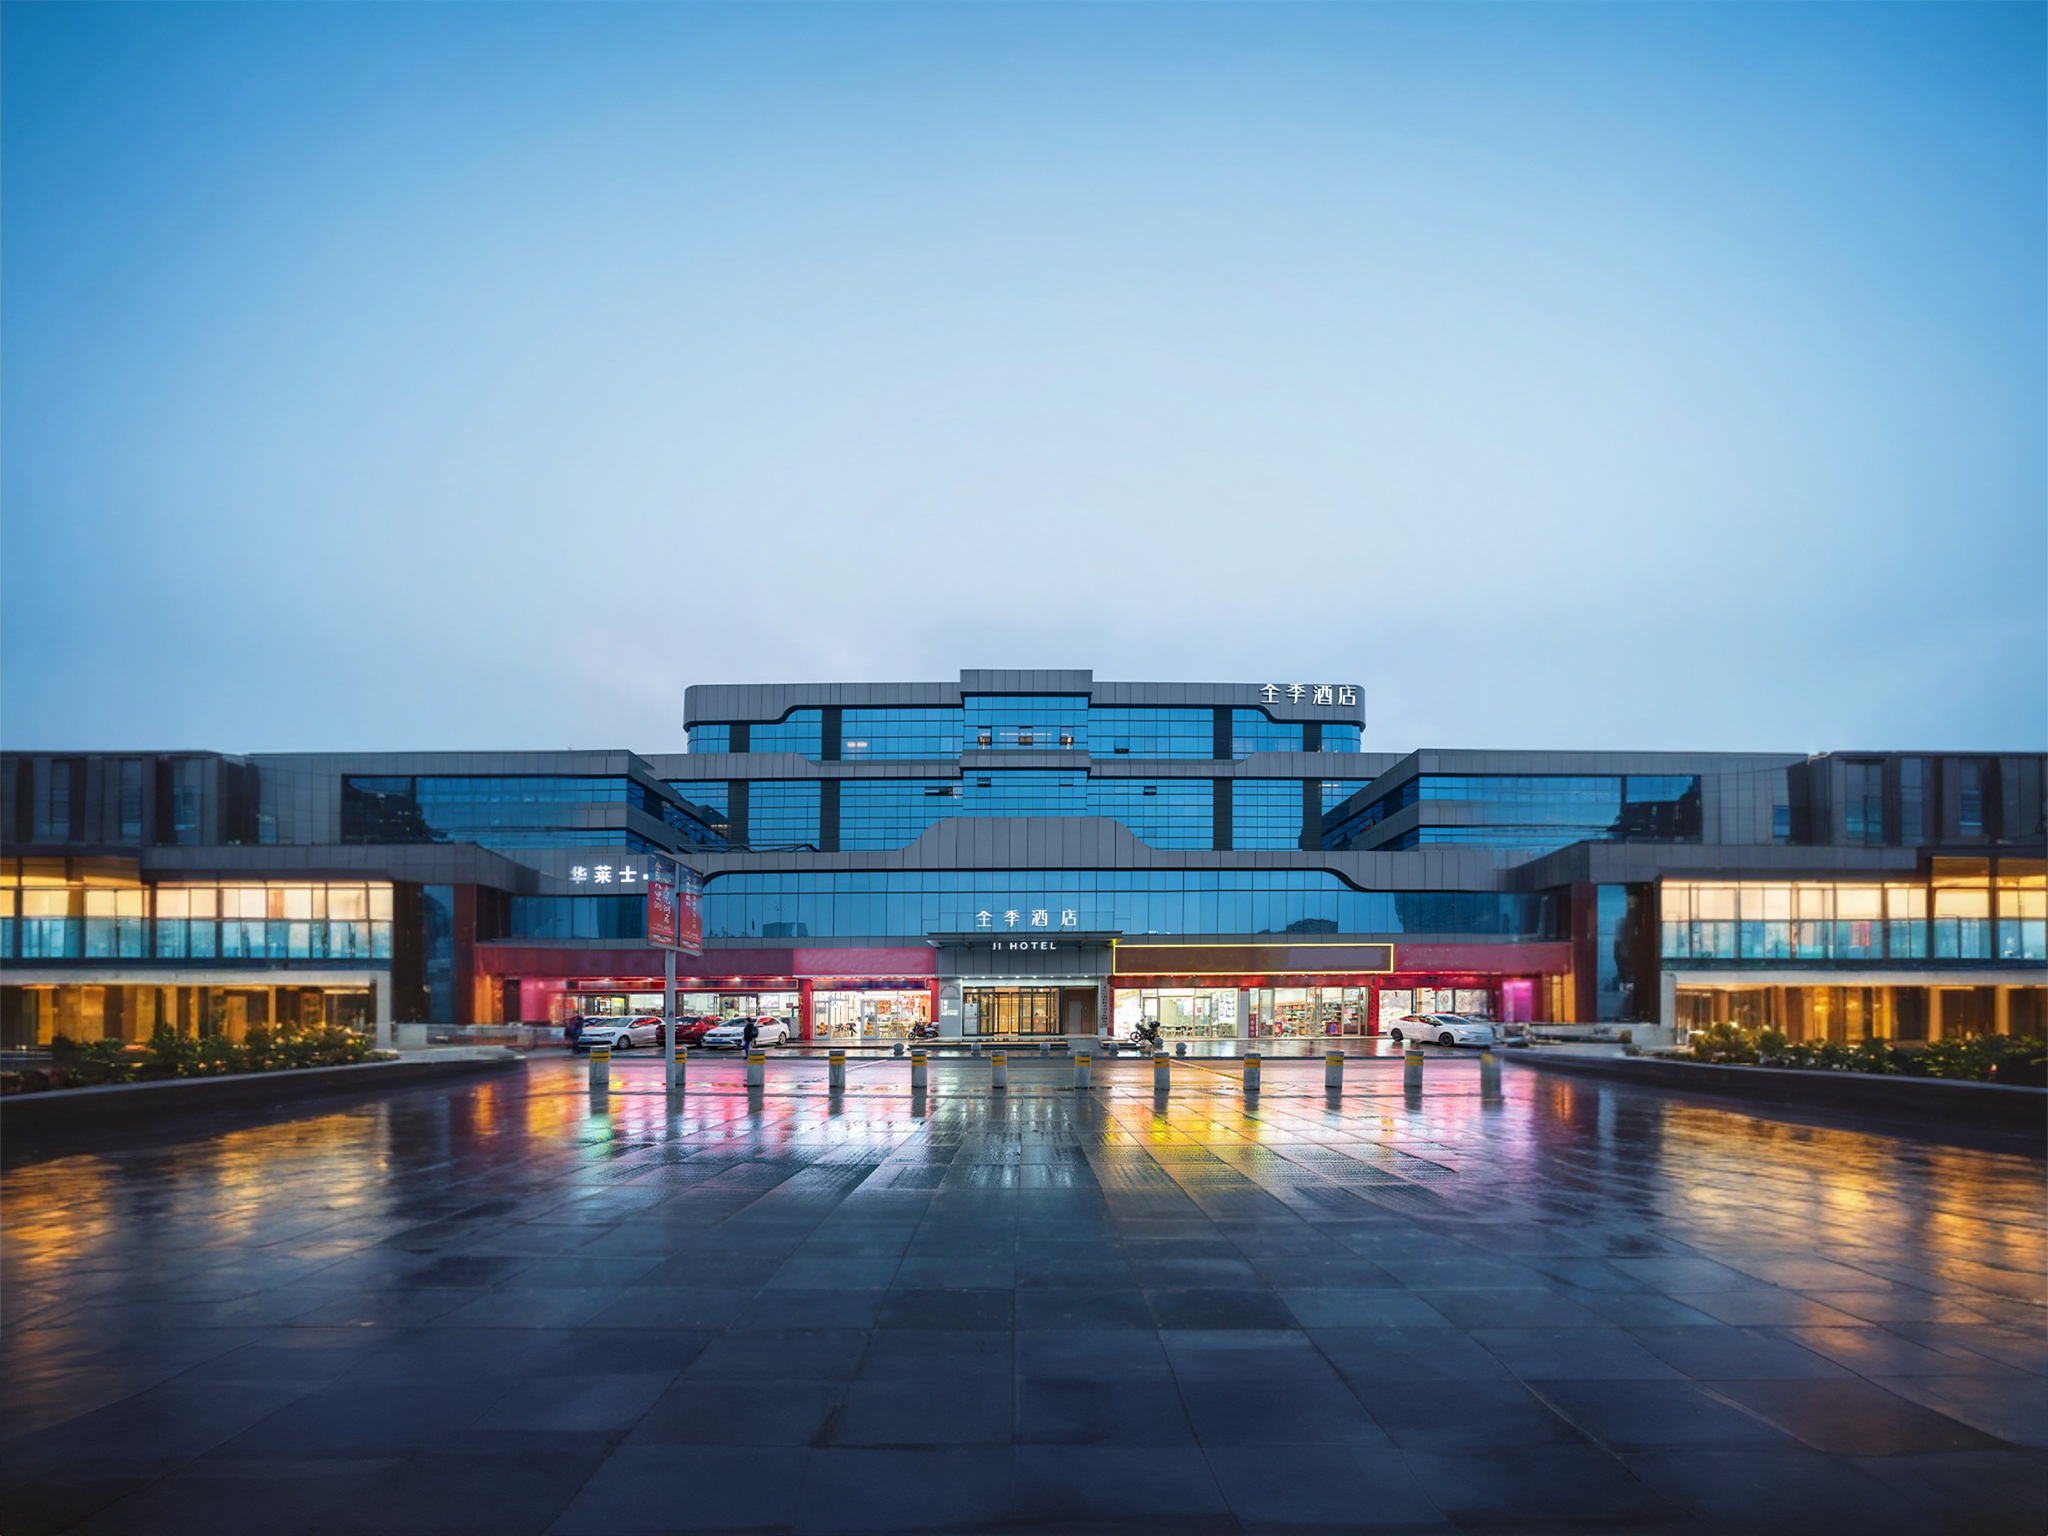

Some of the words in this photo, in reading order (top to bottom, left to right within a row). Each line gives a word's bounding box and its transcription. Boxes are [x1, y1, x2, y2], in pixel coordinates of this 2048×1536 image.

[1259, 683, 1357, 706] 全季酒店
[975, 909, 1077, 928] 全季酒店
[992, 942, 1001, 951] JI
[1009, 941, 1057, 950] HOTEL
